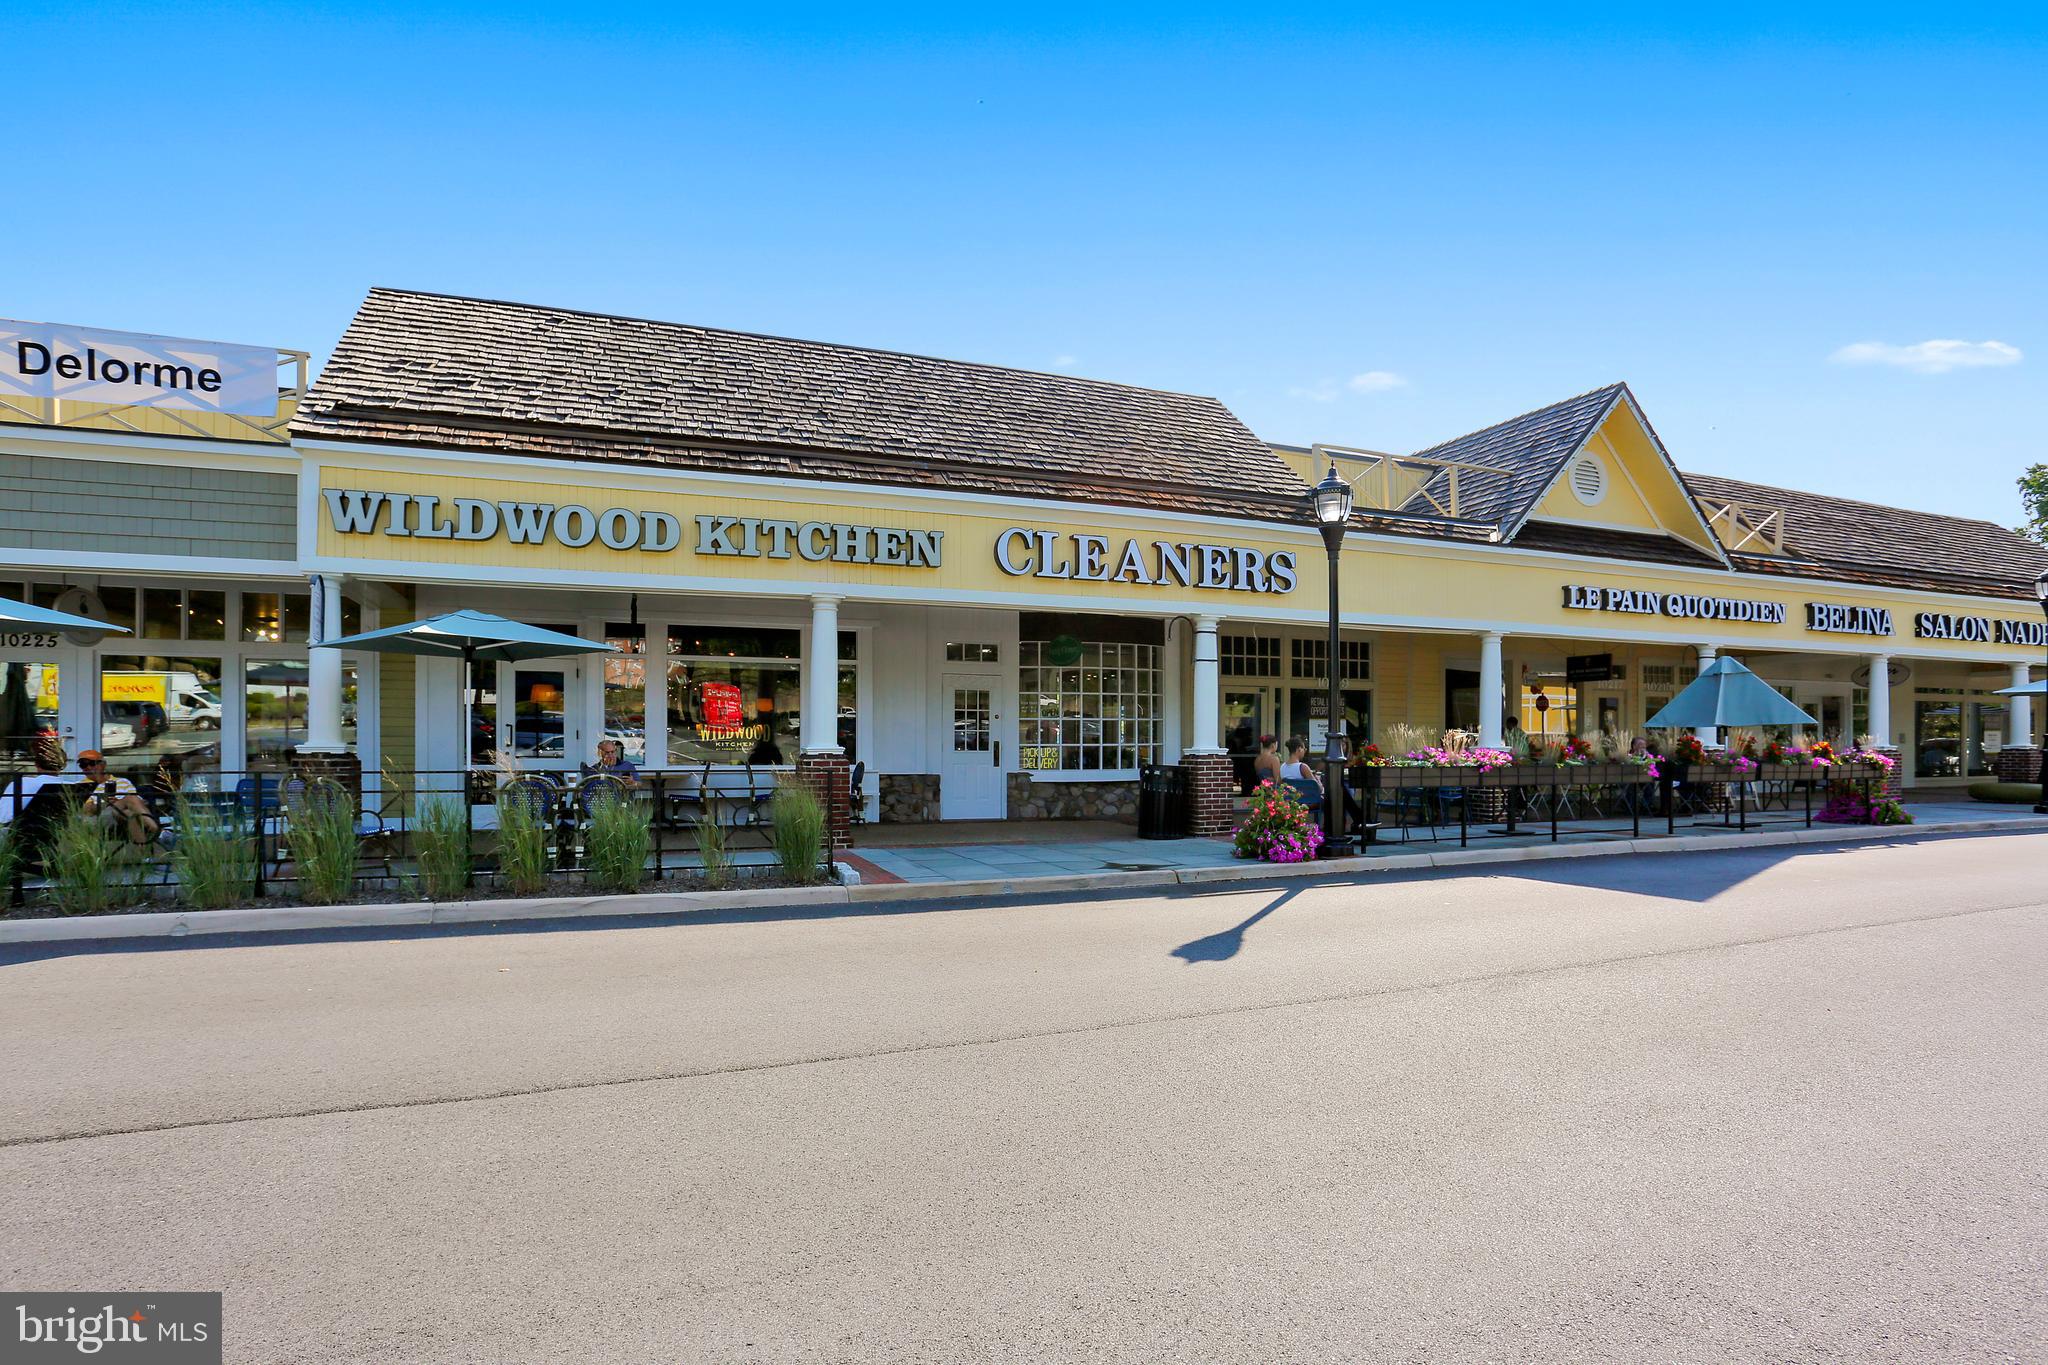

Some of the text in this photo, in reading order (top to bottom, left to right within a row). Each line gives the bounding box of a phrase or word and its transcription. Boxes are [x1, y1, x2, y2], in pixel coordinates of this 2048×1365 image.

[17, 341, 222, 392] Delorme
[322, 488, 945, 568] WILDWOOD KITCHEN
[994, 527, 1298, 594] CLEANERS
[1564, 585, 1788, 624] LE PAIN QUOTIDIEN
[1805, 602, 1896, 636] BELINA
[1, 633, 58, 648] 10225
[1915, 612, 1991, 643] SALON
[1023, 758, 1058, 769] DELVERY
